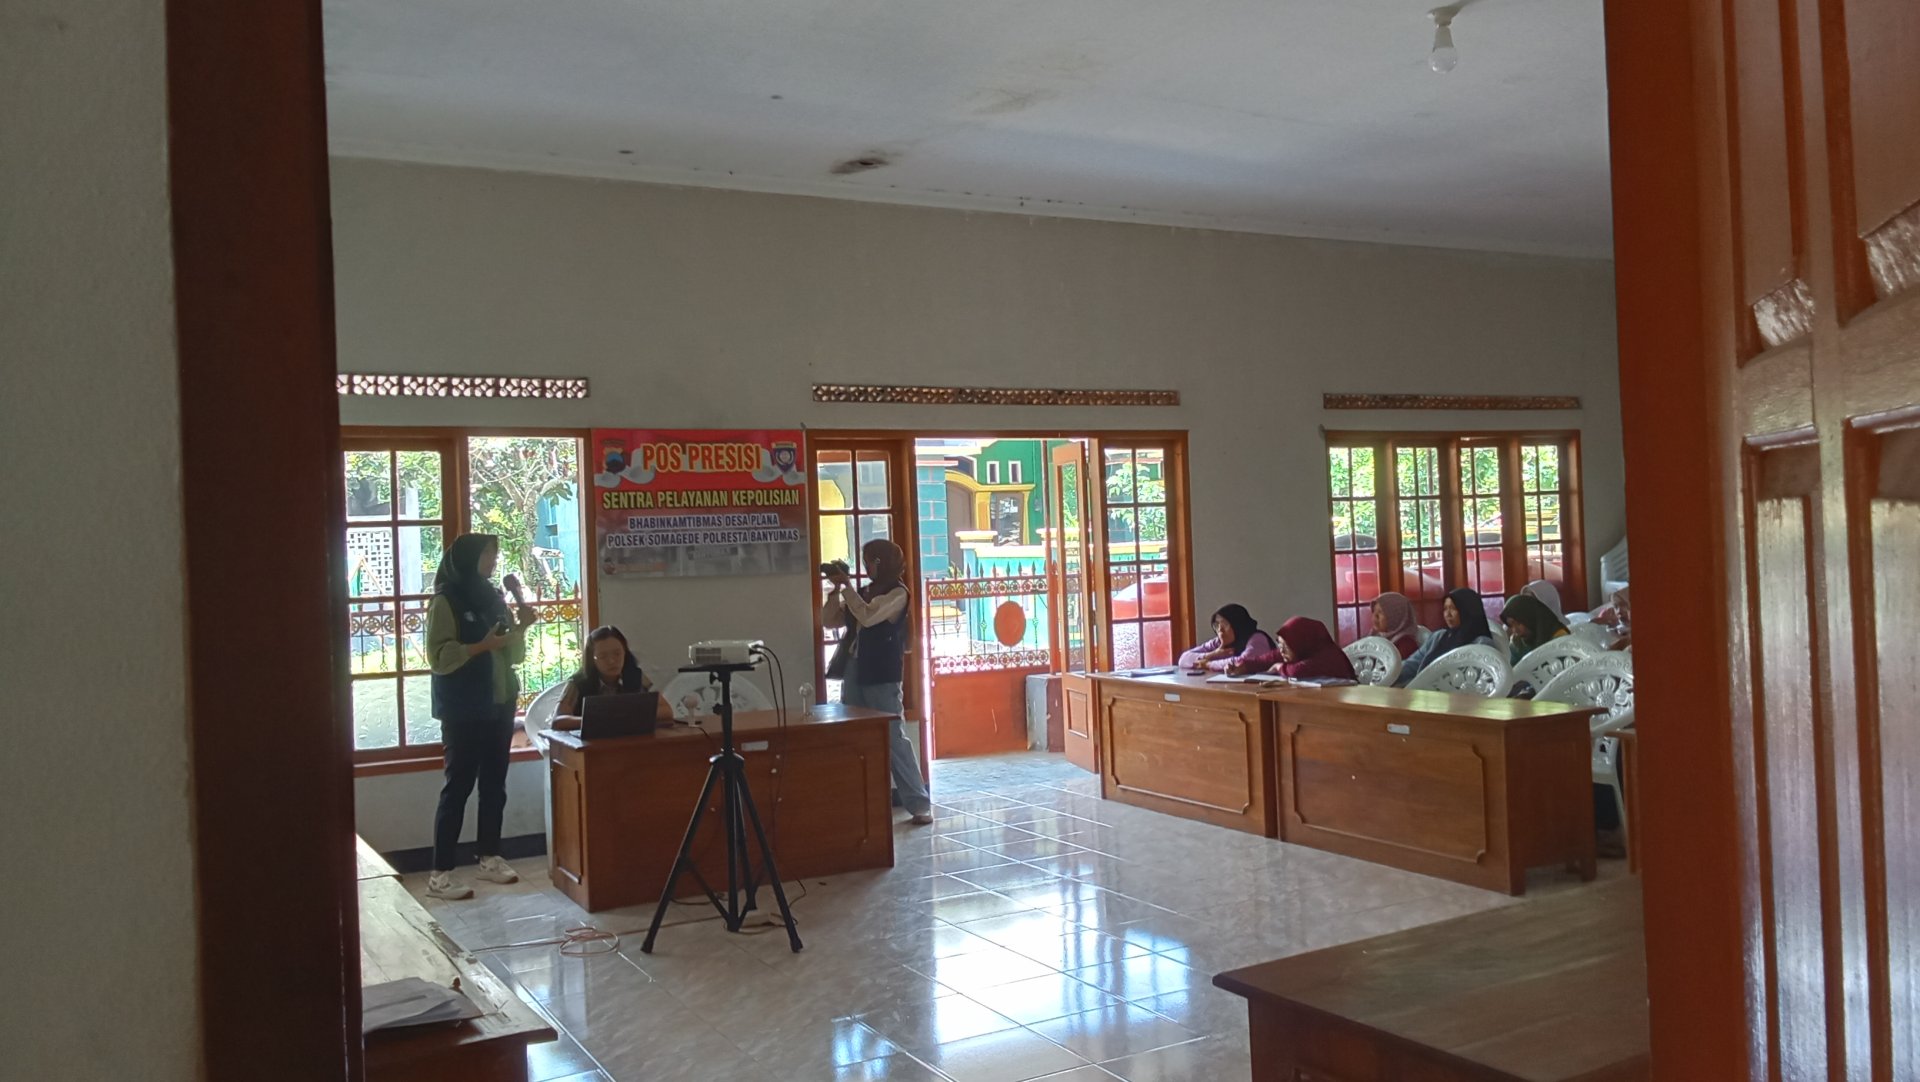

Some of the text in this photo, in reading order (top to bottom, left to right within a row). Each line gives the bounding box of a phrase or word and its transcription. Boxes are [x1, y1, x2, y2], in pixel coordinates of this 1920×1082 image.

[641, 443, 763, 472] POS PRESISI
[603, 489, 800, 509] SENTRA PELAYANAN KEPOLISIAN
[628, 513, 779, 530] BHABINKAMTIBMAS DESA PLANA
[607, 529, 799, 547] POLSEK SOMAGEDE POLRESTA BANYUMAS
